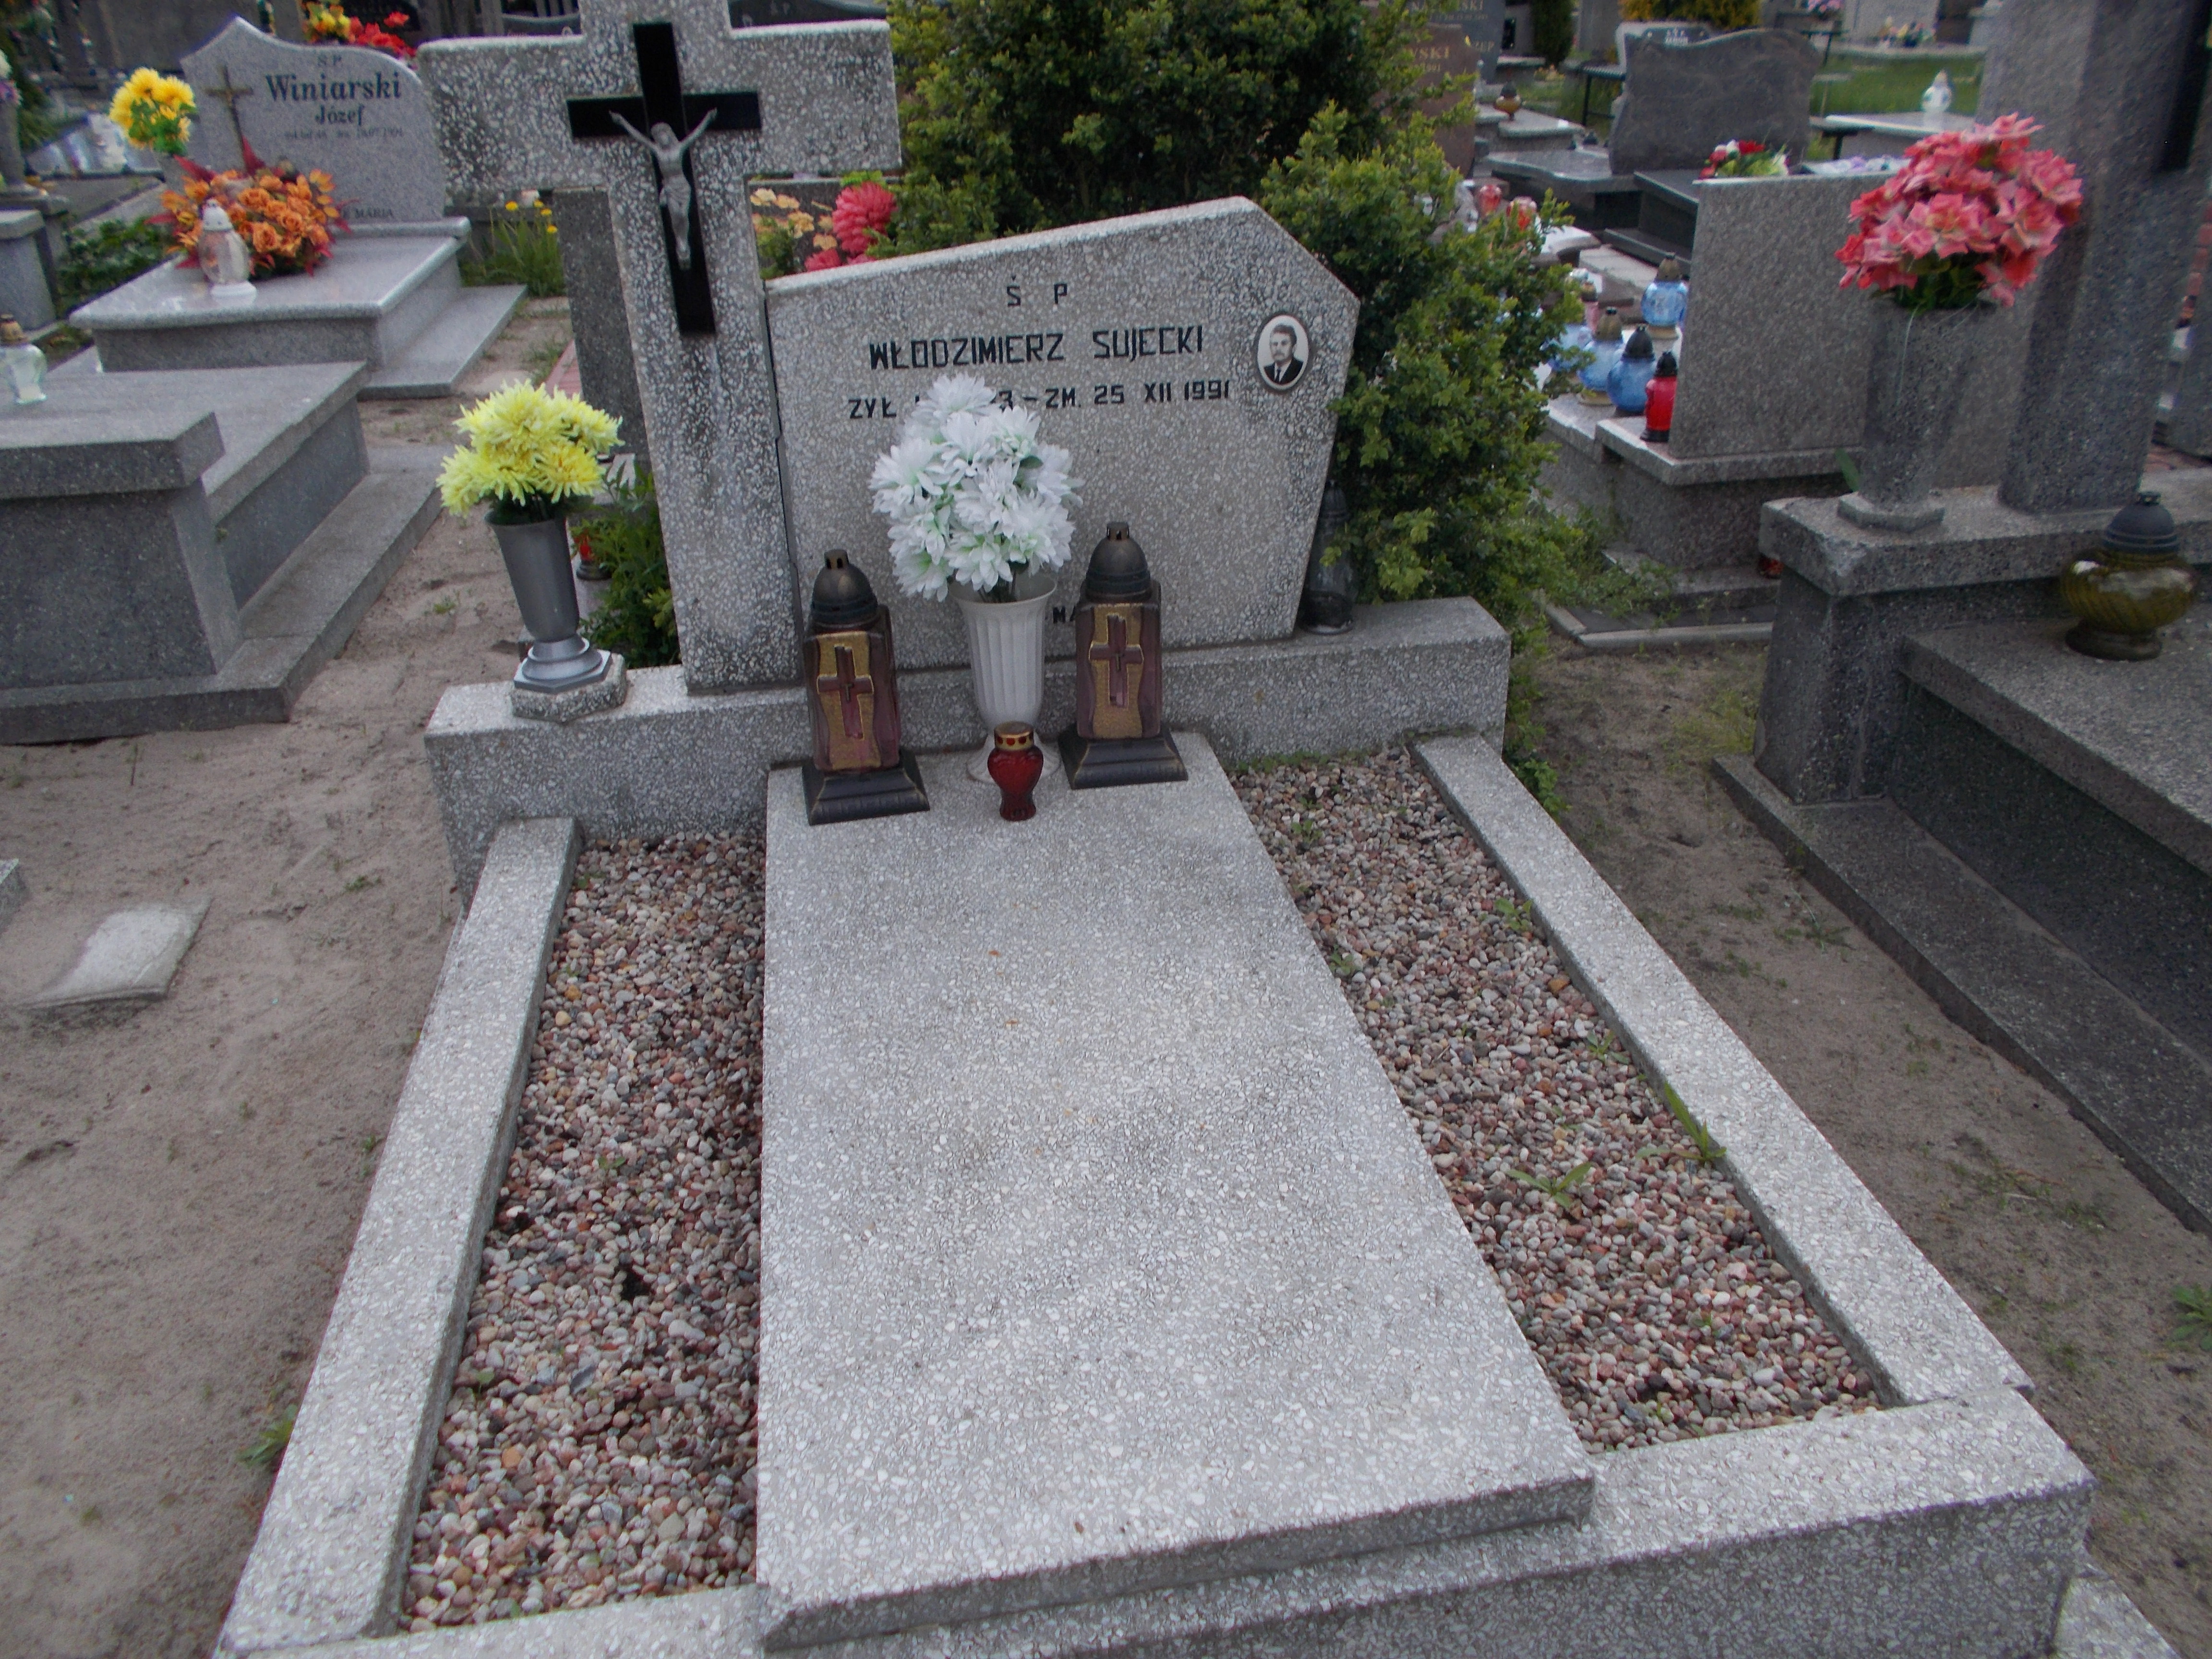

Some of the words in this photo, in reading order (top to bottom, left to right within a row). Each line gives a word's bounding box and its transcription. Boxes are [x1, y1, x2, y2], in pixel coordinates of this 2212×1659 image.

[265, 72, 401, 101] Winiarski
[314, 103, 365, 126] Józef
[1053, 282, 1068, 305] P
[869, 332, 1065, 370] WŁODZIMIERZ
[1092, 325, 1203, 362] SUJECKI
[1094, 384, 1125, 405] 25
[1144, 381, 1172, 403] XII
[1184, 379, 1230, 401] 1991
